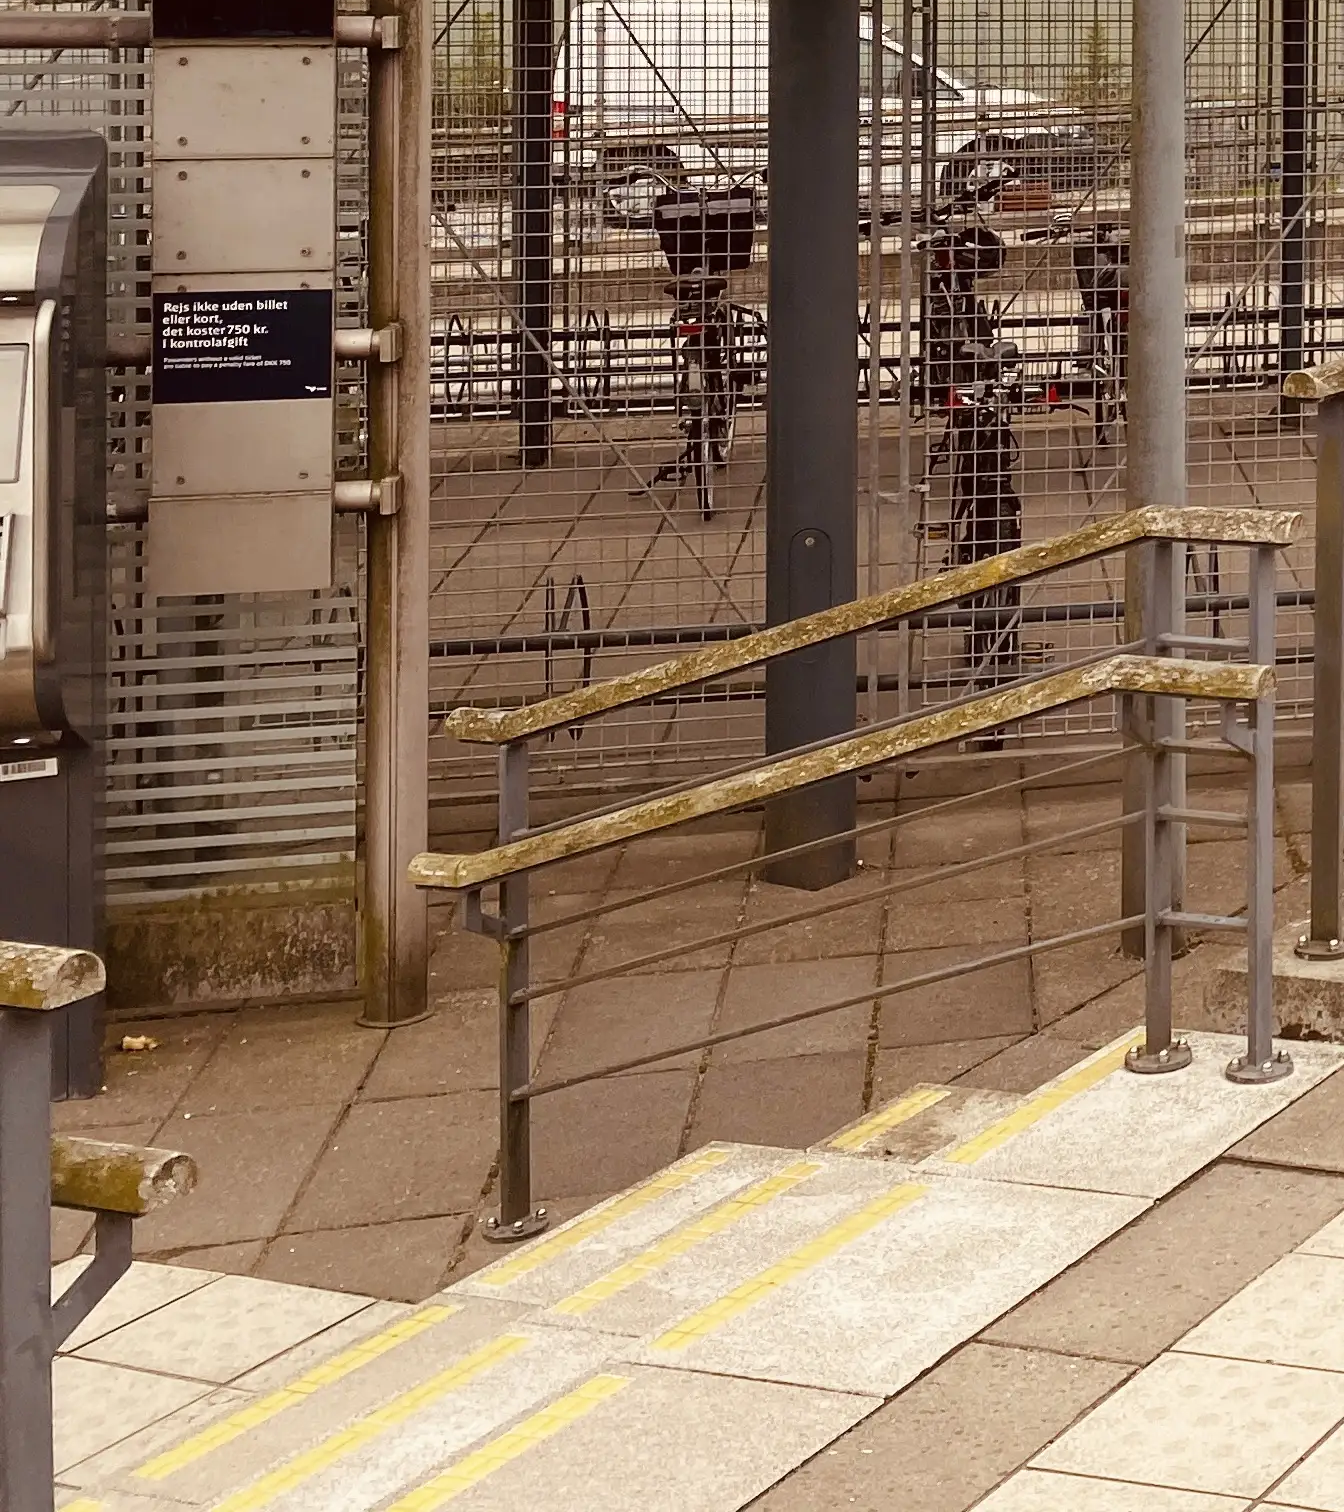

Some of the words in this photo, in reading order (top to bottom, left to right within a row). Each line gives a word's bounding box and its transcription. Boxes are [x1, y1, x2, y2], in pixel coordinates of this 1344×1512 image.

[164, 303, 190, 314] Rejs
[193, 302, 219, 312] ikke
[222, 301, 253, 311] uden
[256, 299, 288, 310] billet
[162, 315, 191, 325] eller
[194, 314, 223, 325] kort,
[162, 326, 183, 337] det
[186, 326, 225, 336] koster
[227, 325, 250, 335] 750
[254, 324, 269, 334] kr.
[170, 337, 249, 349] kontrolafgift
